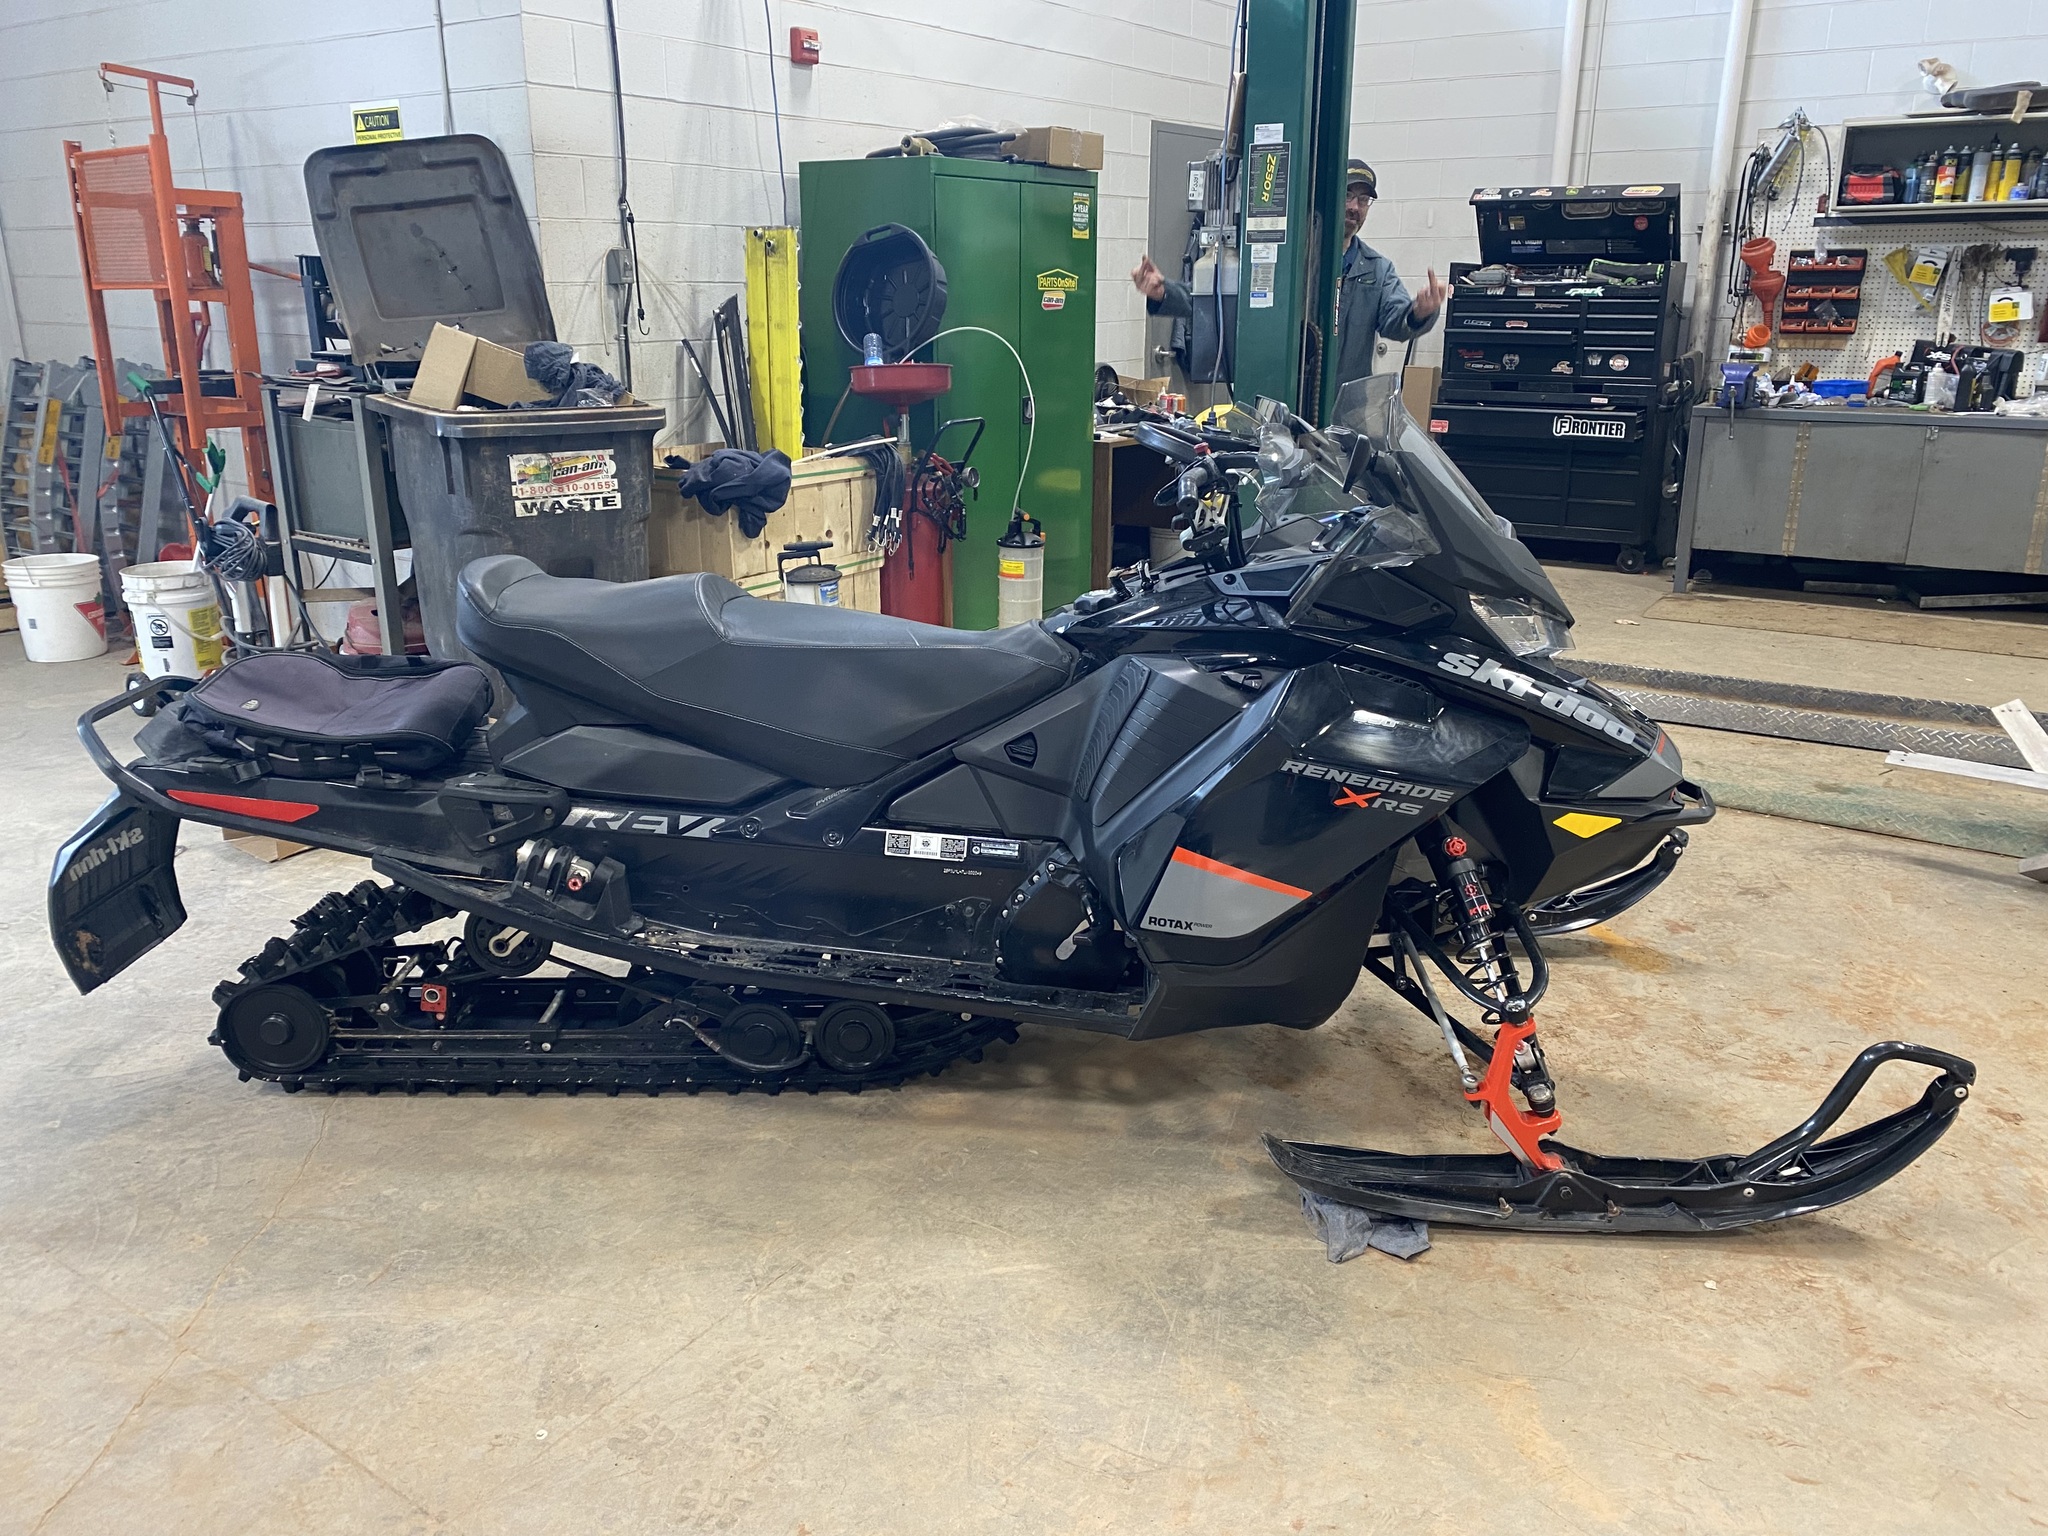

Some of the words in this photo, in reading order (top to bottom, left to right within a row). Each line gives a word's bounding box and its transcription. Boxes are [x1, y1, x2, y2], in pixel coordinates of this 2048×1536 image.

[365, 114, 389, 127] CAUTION
[1263, 153, 1277, 191] Z530
[1043, 296, 1064, 304] can-am
[1555, 415, 1625, 437] FRONTIER
[521, 496, 617, 514] WASTE
[1437, 652, 1635, 744] ski-doo
[1279, 759, 1454, 803] RENEGADE
[1148, 916, 1194, 931] ROTAX
